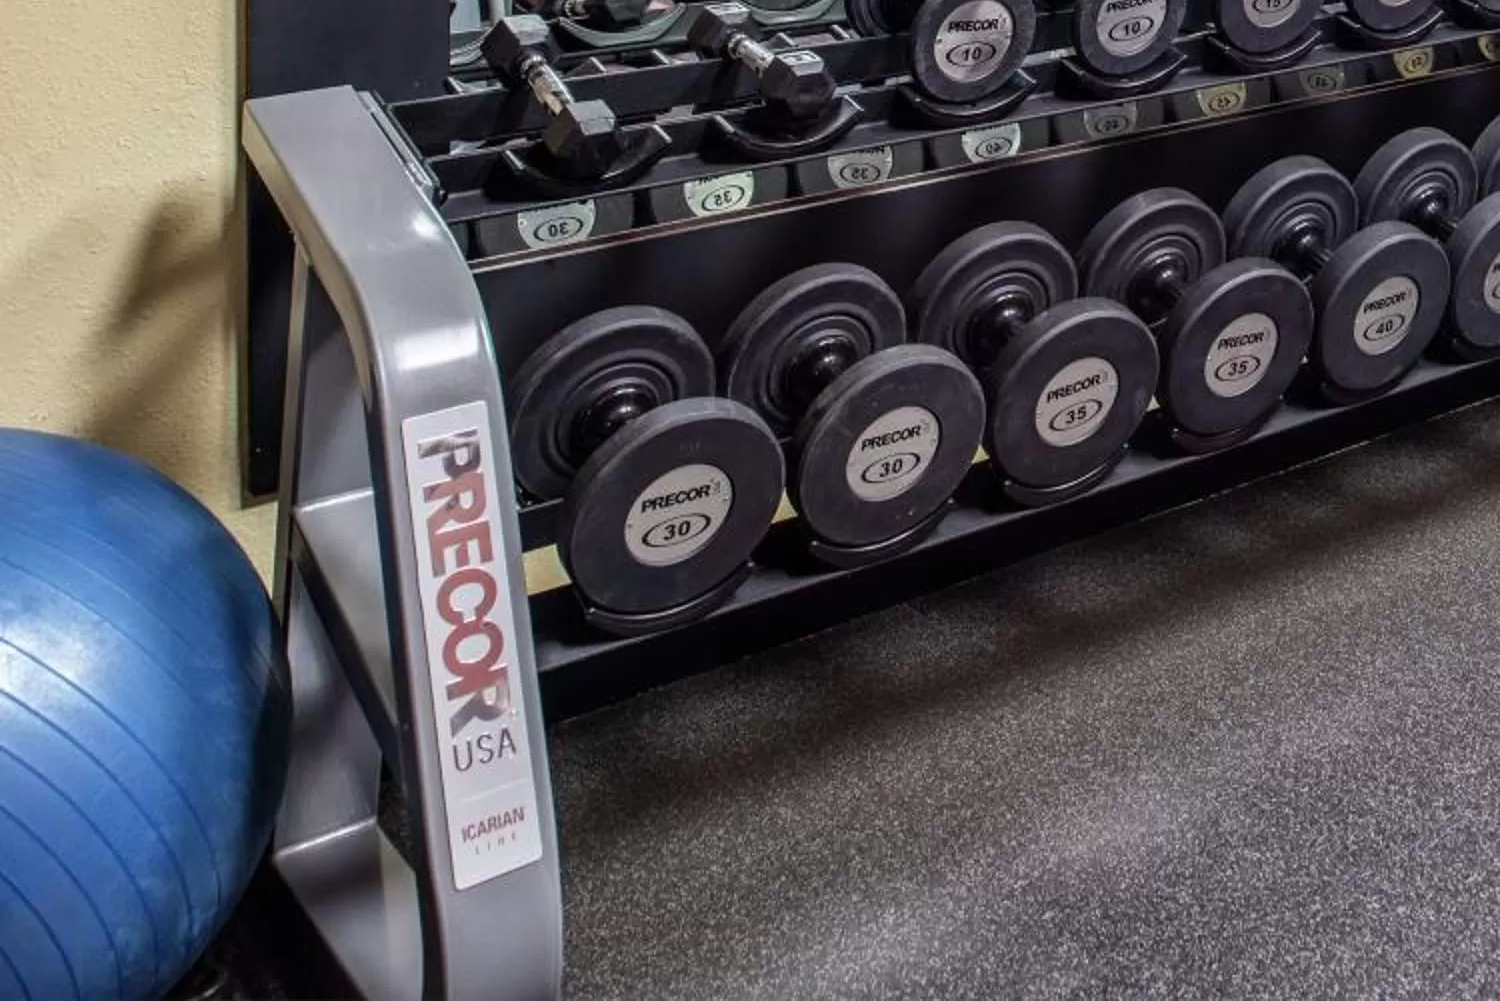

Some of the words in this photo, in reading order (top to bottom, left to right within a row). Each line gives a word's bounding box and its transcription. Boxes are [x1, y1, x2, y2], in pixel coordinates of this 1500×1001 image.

[948, 18, 999, 34] PRECOR
[1123, 20, 1142, 35] 10
[963, 46, 982, 60] 10
[1363, 291, 1406, 315] PRECOR
[1375, 318, 1394, 334] 40
[1217, 331, 1265, 350] PRECOR
[1227, 360, 1248, 376] 35
[1046, 374, 1102, 404] PRECOR
[1066, 406, 1087, 425] 35
[861, 425, 921, 452] PRECOR
[879, 459, 903, 478] 30
[641, 485, 711, 514] PRECOR
[664, 520, 691, 541] 30
[417, 428, 512, 738] PRECOR
[453, 727, 516, 772] USA
[462, 806, 526, 843] ICARIAN
